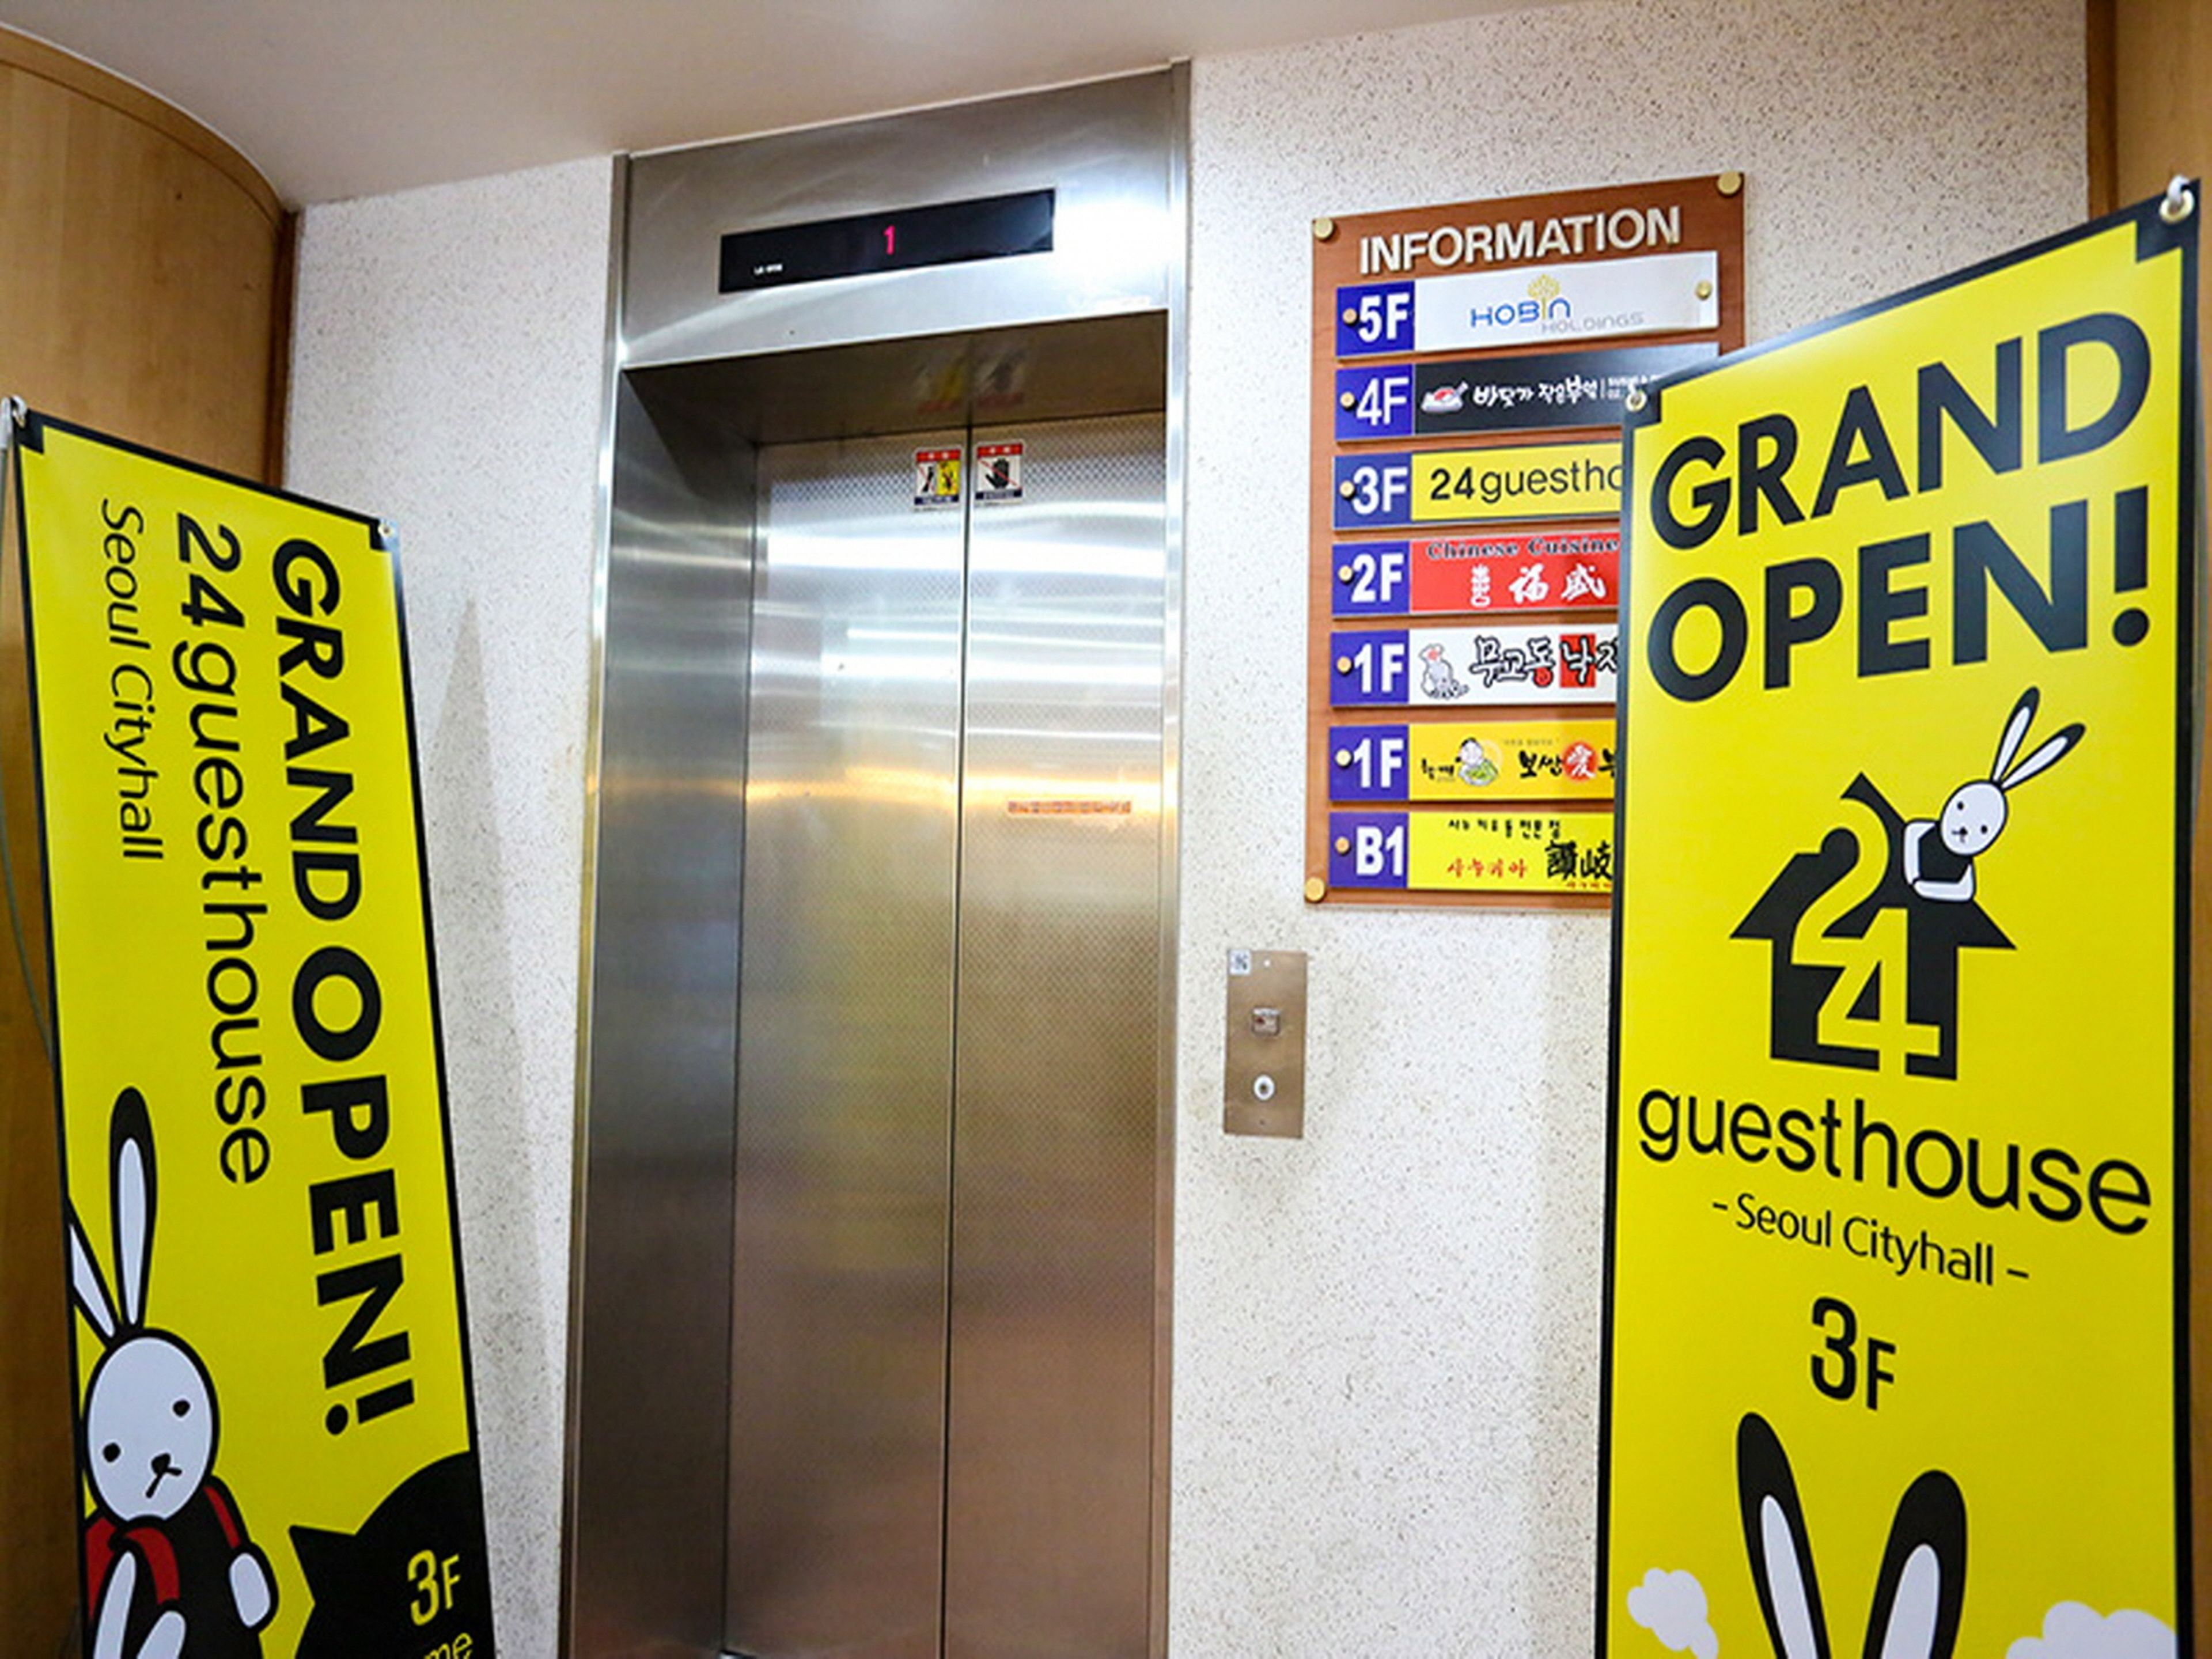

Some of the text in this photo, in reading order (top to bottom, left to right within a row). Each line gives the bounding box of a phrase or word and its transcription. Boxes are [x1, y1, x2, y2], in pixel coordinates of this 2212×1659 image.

[882, 225, 896, 256] 1
[1360, 206, 1681, 275] INFORMATION
[1358, 291, 1411, 343] 5F
[1355, 376, 1409, 426] 4F
[1650, 313, 2151, 550] GRAND
[1352, 467, 1408, 515] 3F
[1351, 553, 1404, 604] 2F
[1427, 538, 1619, 559] Chinese Cuisine
[1647, 485, 2149, 702] OPEN!
[101, 498, 164, 861] Seoul Cityhall
[1354, 642, 1405, 694] 1F
[1354, 736, 1405, 789] 1F
[172, 512, 271, 1184] 24guesthouse
[1355, 825, 1405, 876] B1
[272, 539, 415, 1435] GRAND OPEN!
[1639, 1088, 2152, 1236] guesthouse
[1736, 1191, 1832, 1249] Seoul
[1843, 1215, 1994, 1287] Cityhall
[1810, 1296, 1896, 1410] 3F
[407, 1549, 461, 1627] 3F
